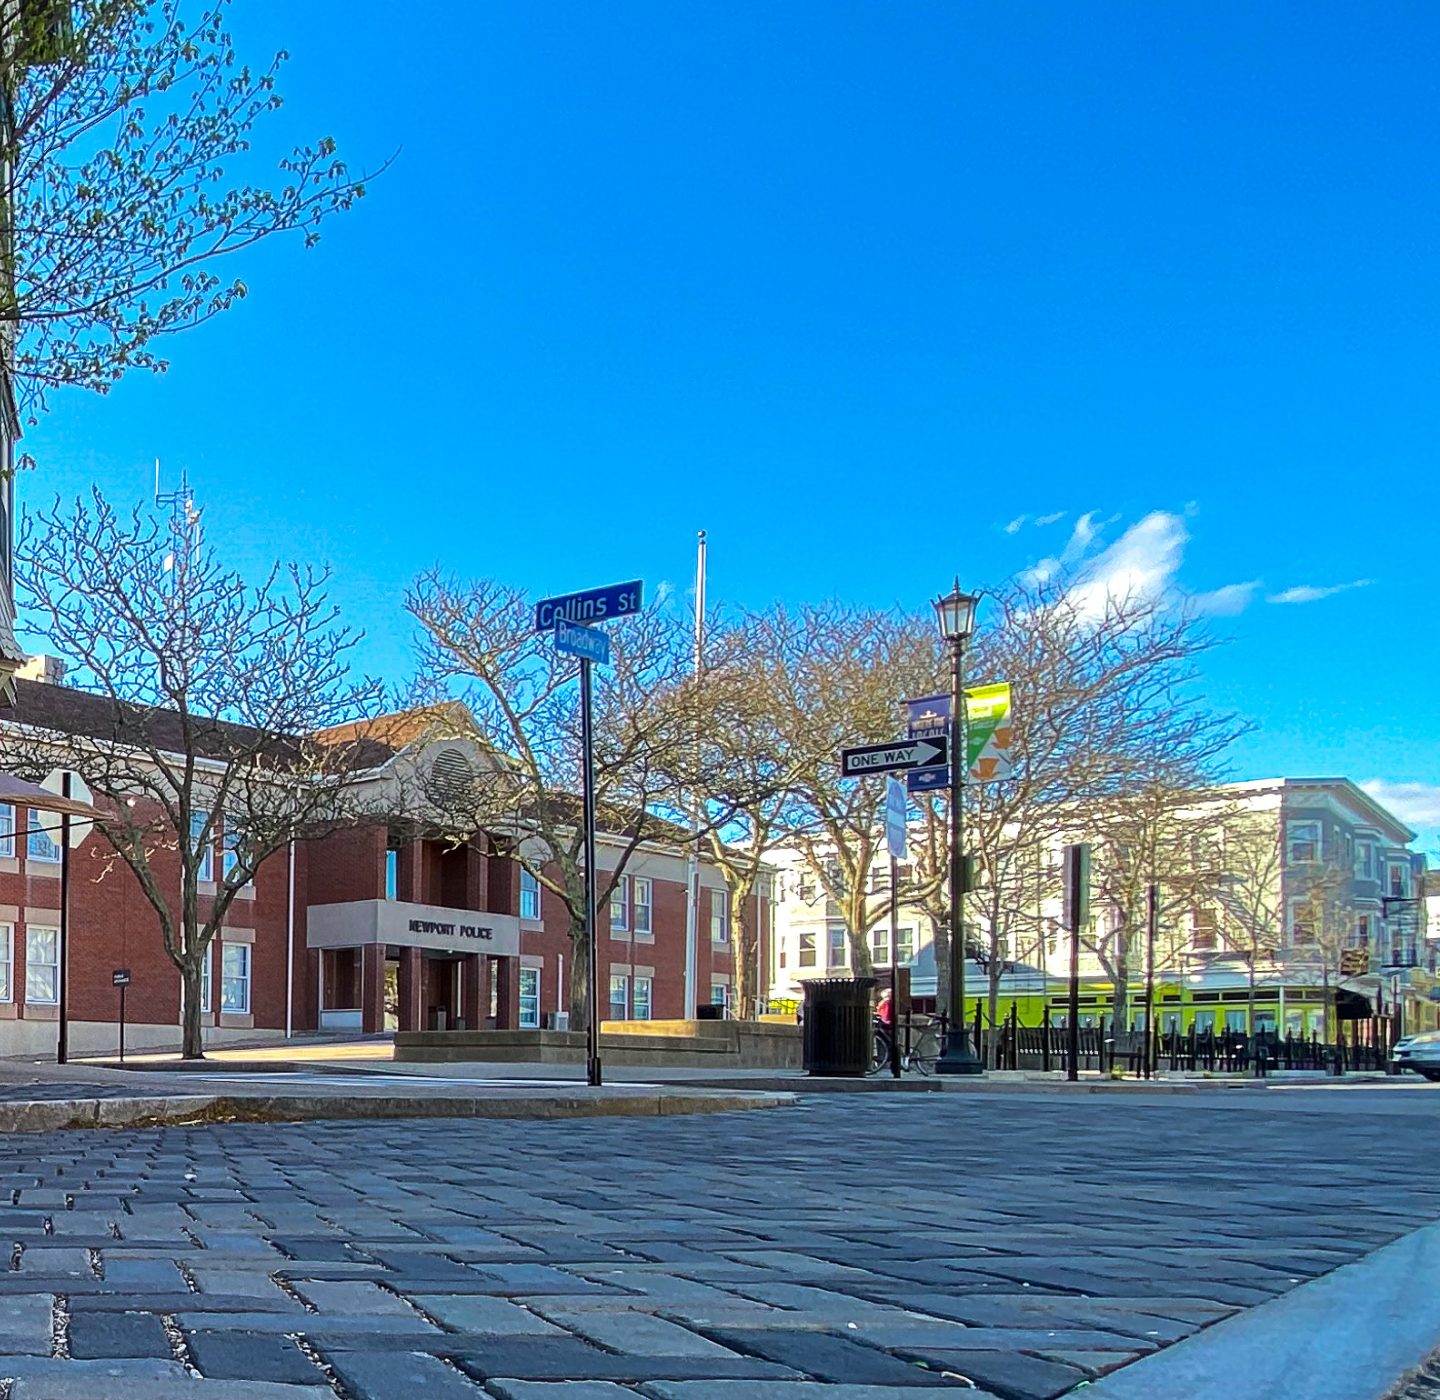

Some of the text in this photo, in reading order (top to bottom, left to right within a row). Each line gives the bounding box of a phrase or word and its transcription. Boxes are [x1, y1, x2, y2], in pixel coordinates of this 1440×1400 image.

[541, 592, 637, 627] Collins St
[559, 621, 608, 656] Broadway
[851, 749, 915, 768] ONE WAY
[409, 919, 493, 940] NEWPORT POLICE
